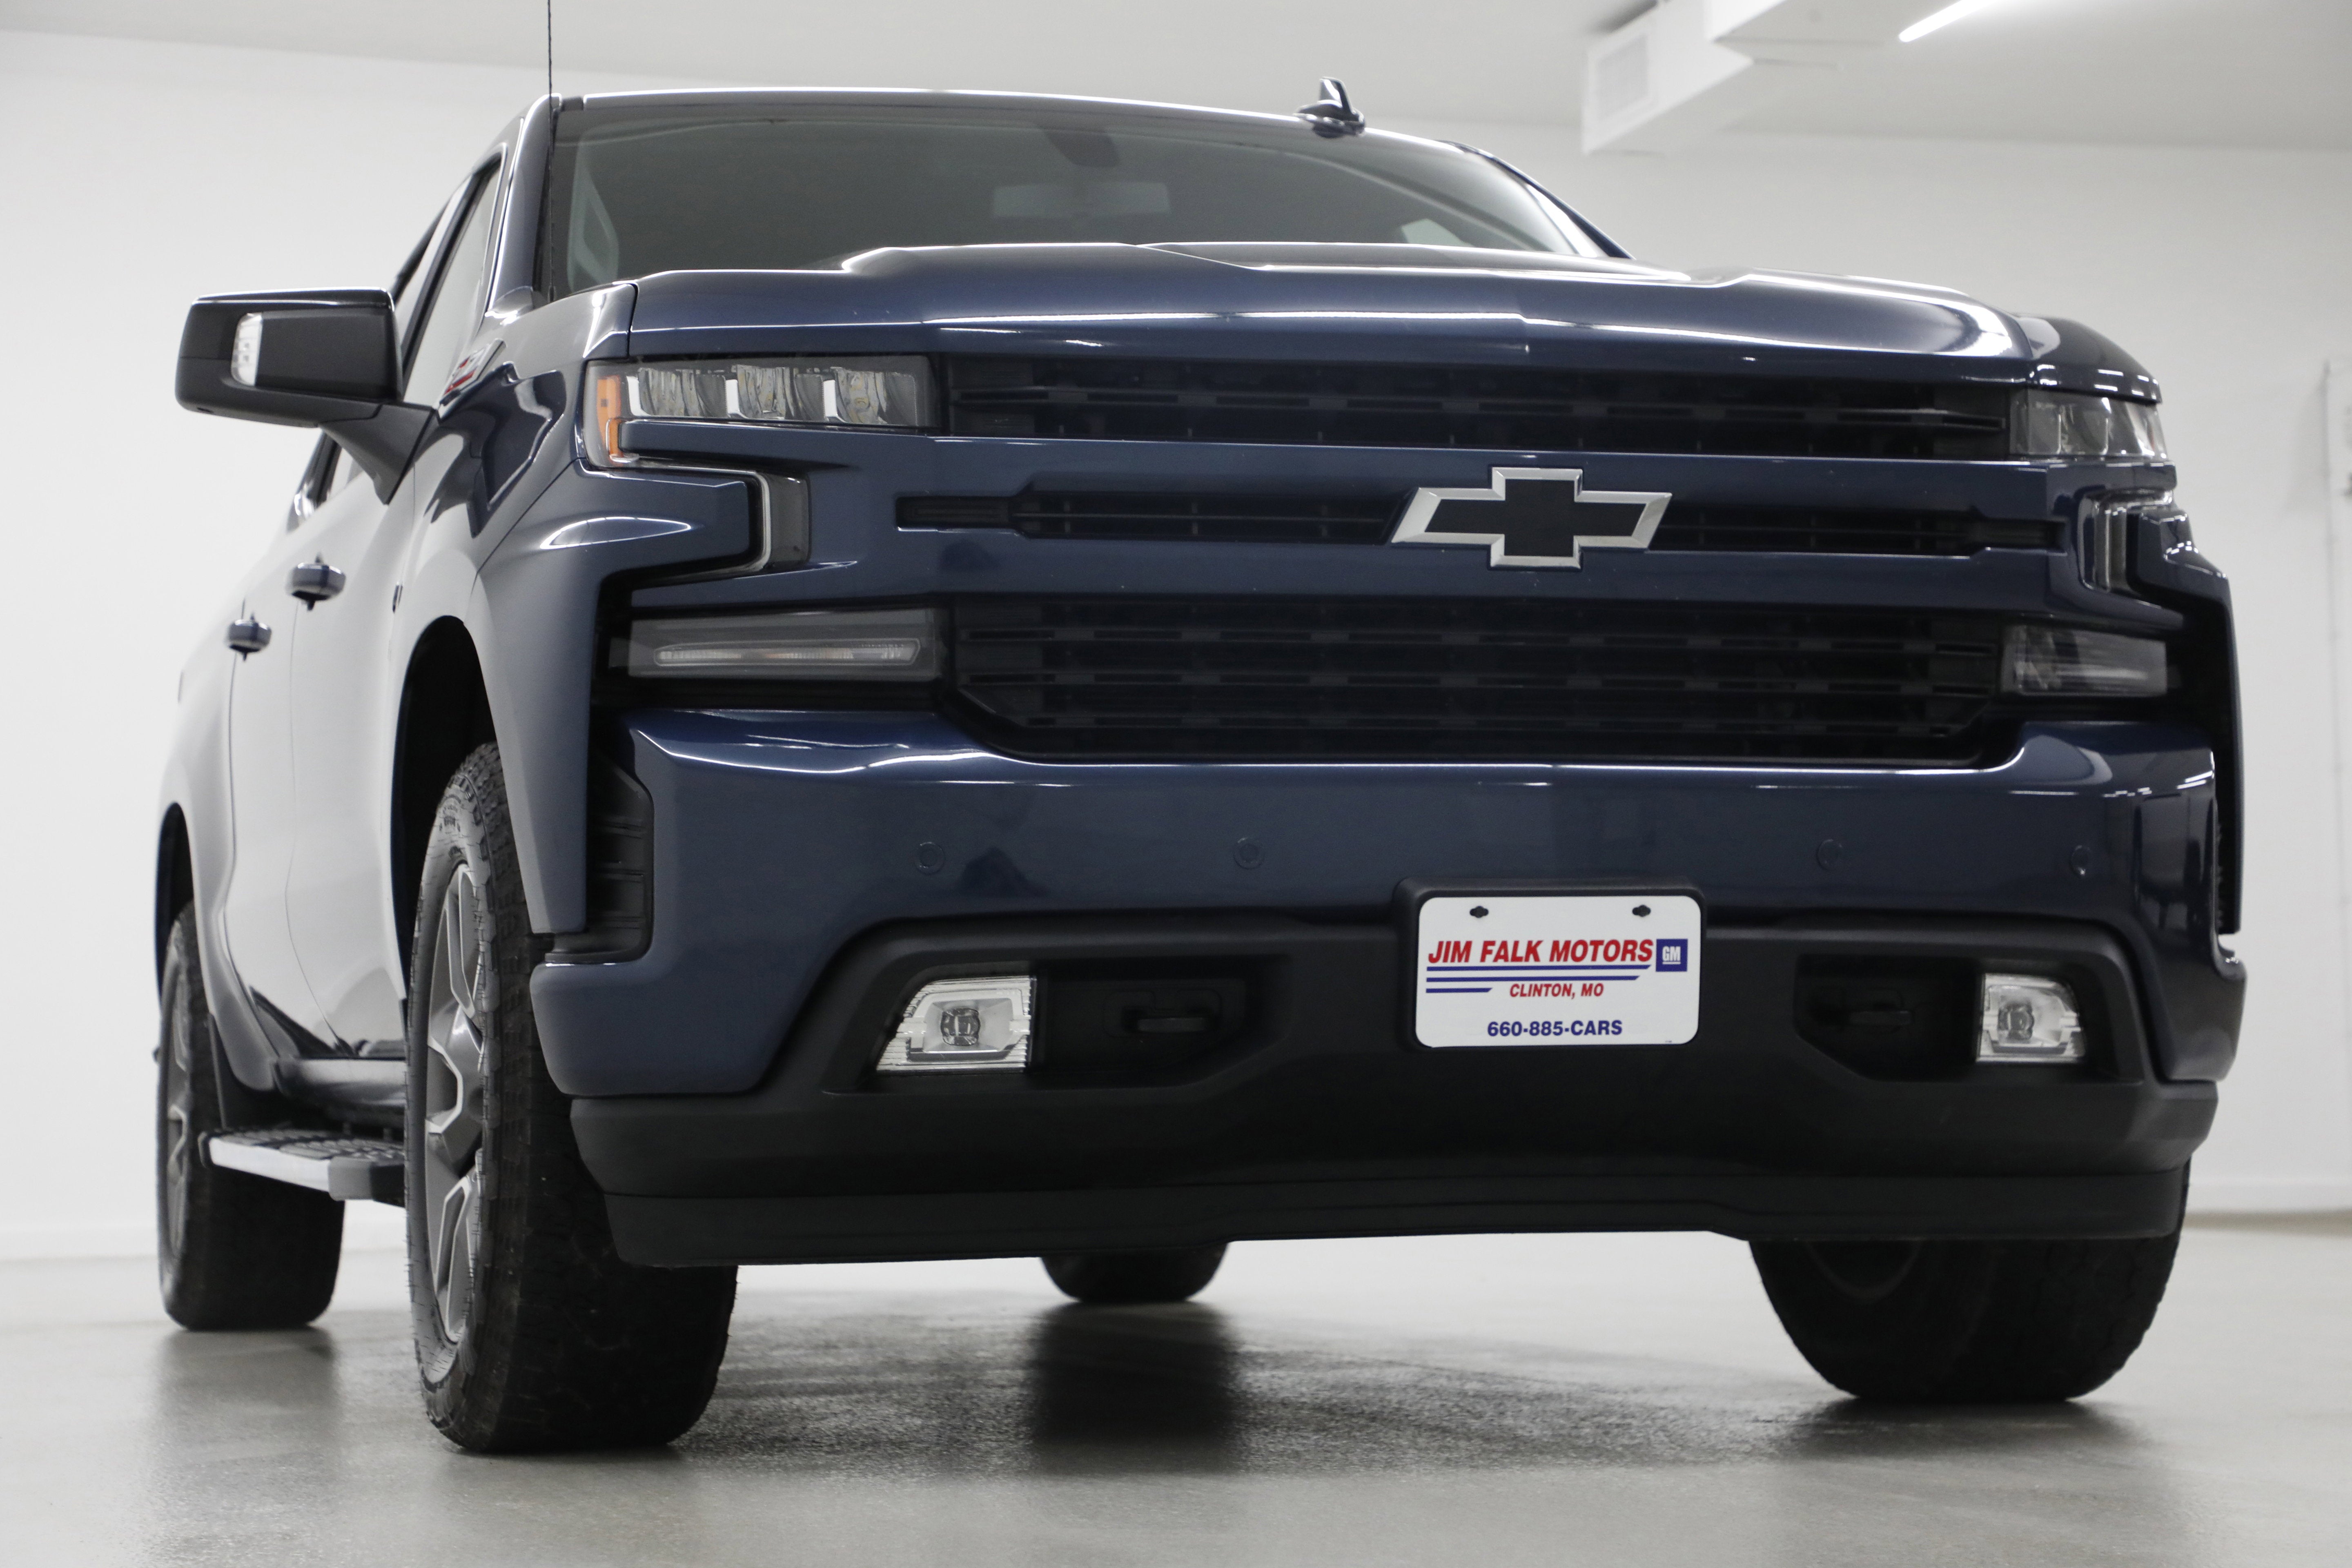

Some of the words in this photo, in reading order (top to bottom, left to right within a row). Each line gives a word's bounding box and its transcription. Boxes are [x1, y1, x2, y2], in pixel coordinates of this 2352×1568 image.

[1428, 940, 1472, 963] JIM
[1480, 940, 1543, 962] FALK
[1549, 939, 1653, 962] MOTORS
[1662, 946, 1681, 961] GM
[1510, 983, 1575, 999] CLINTON,
[1581, 983, 1604, 997] MO
[1487, 1020, 1622, 1037] 660-885-CARS
